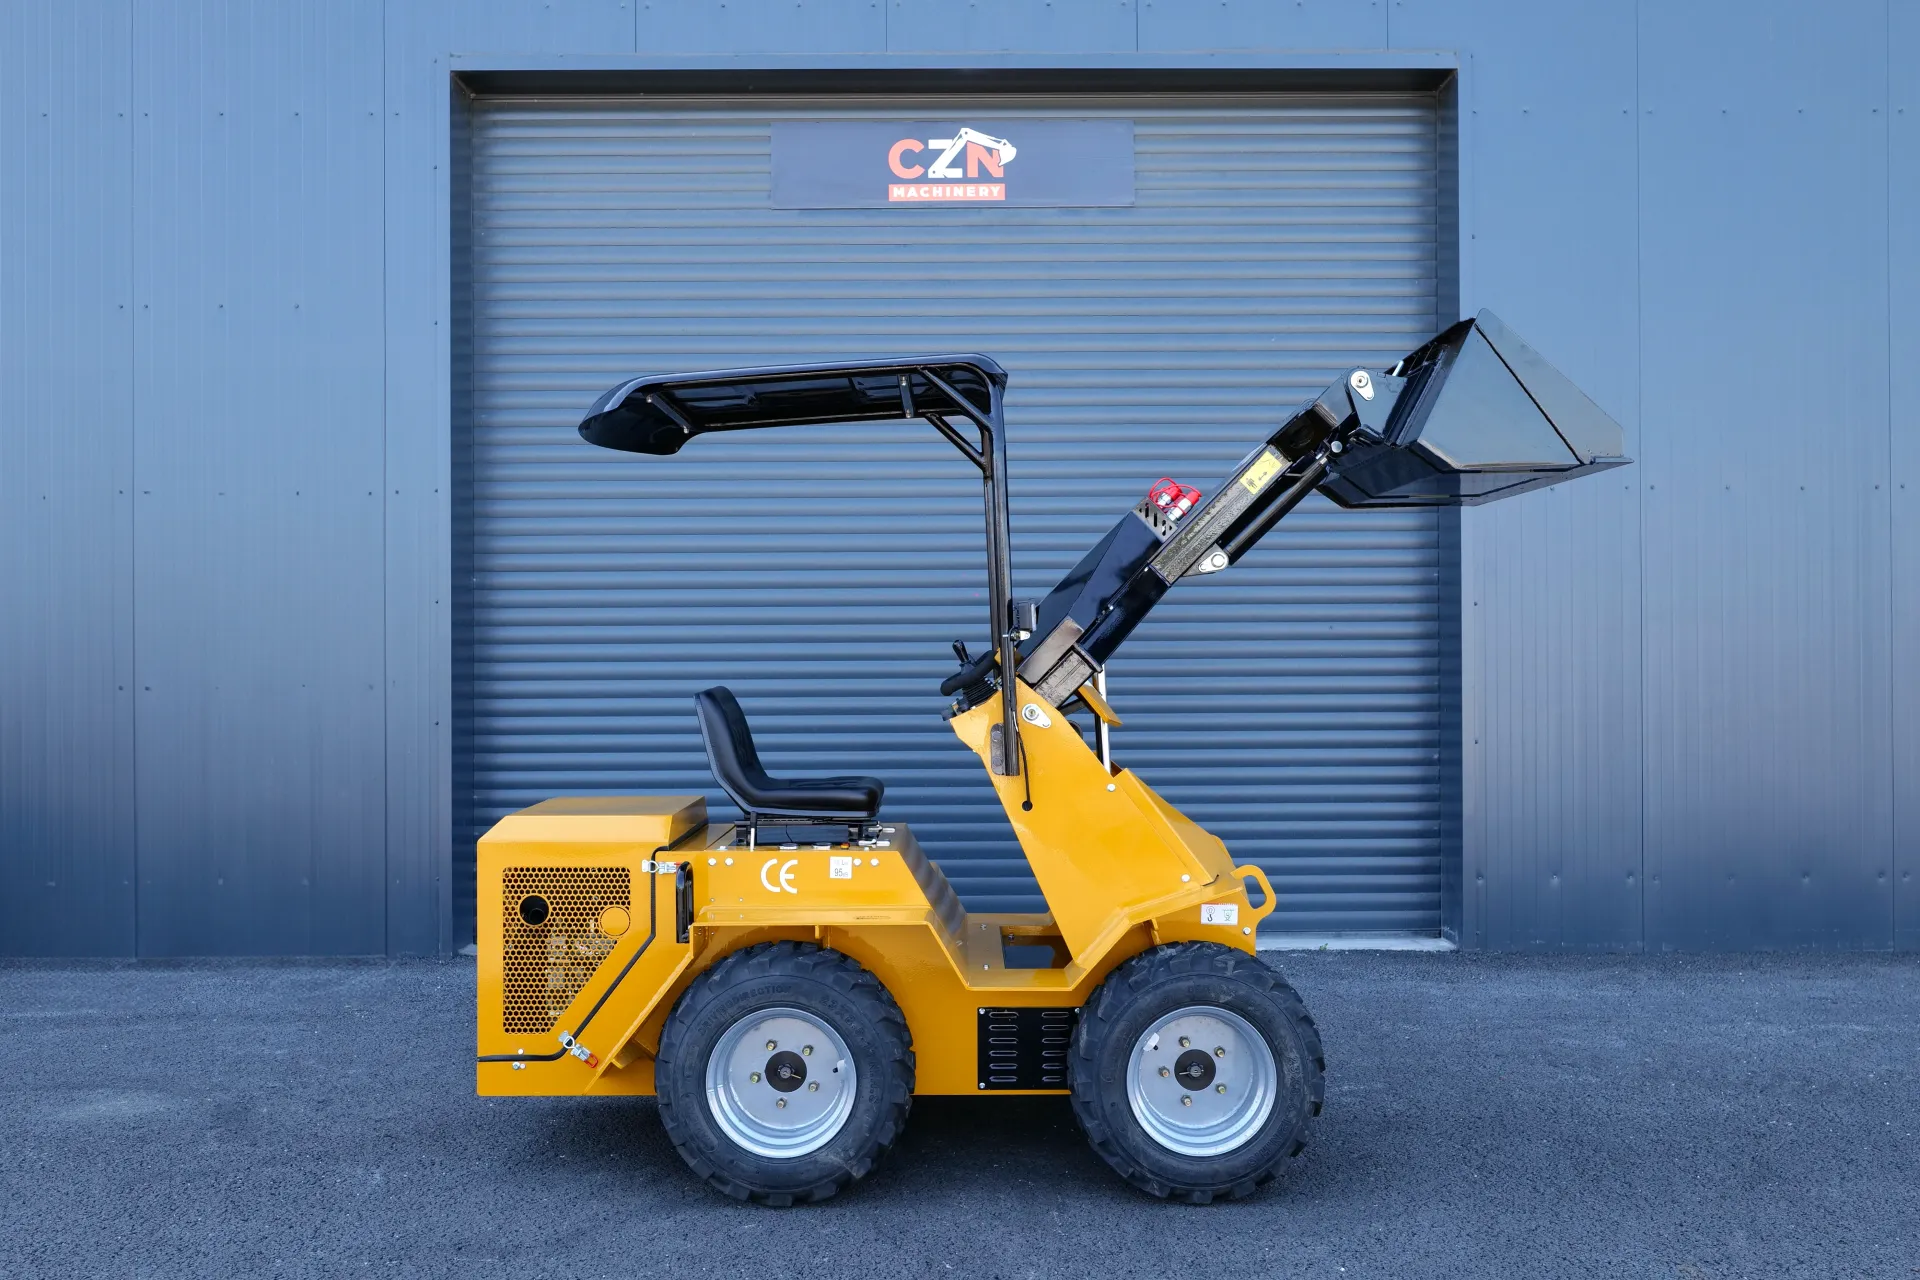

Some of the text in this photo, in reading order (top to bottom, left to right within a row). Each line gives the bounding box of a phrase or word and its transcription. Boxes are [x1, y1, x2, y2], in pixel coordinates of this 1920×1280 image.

[888, 138, 1005, 179] CZN
[893, 186, 1001, 198] MACHINERY
[760, 858, 799, 894] CE
